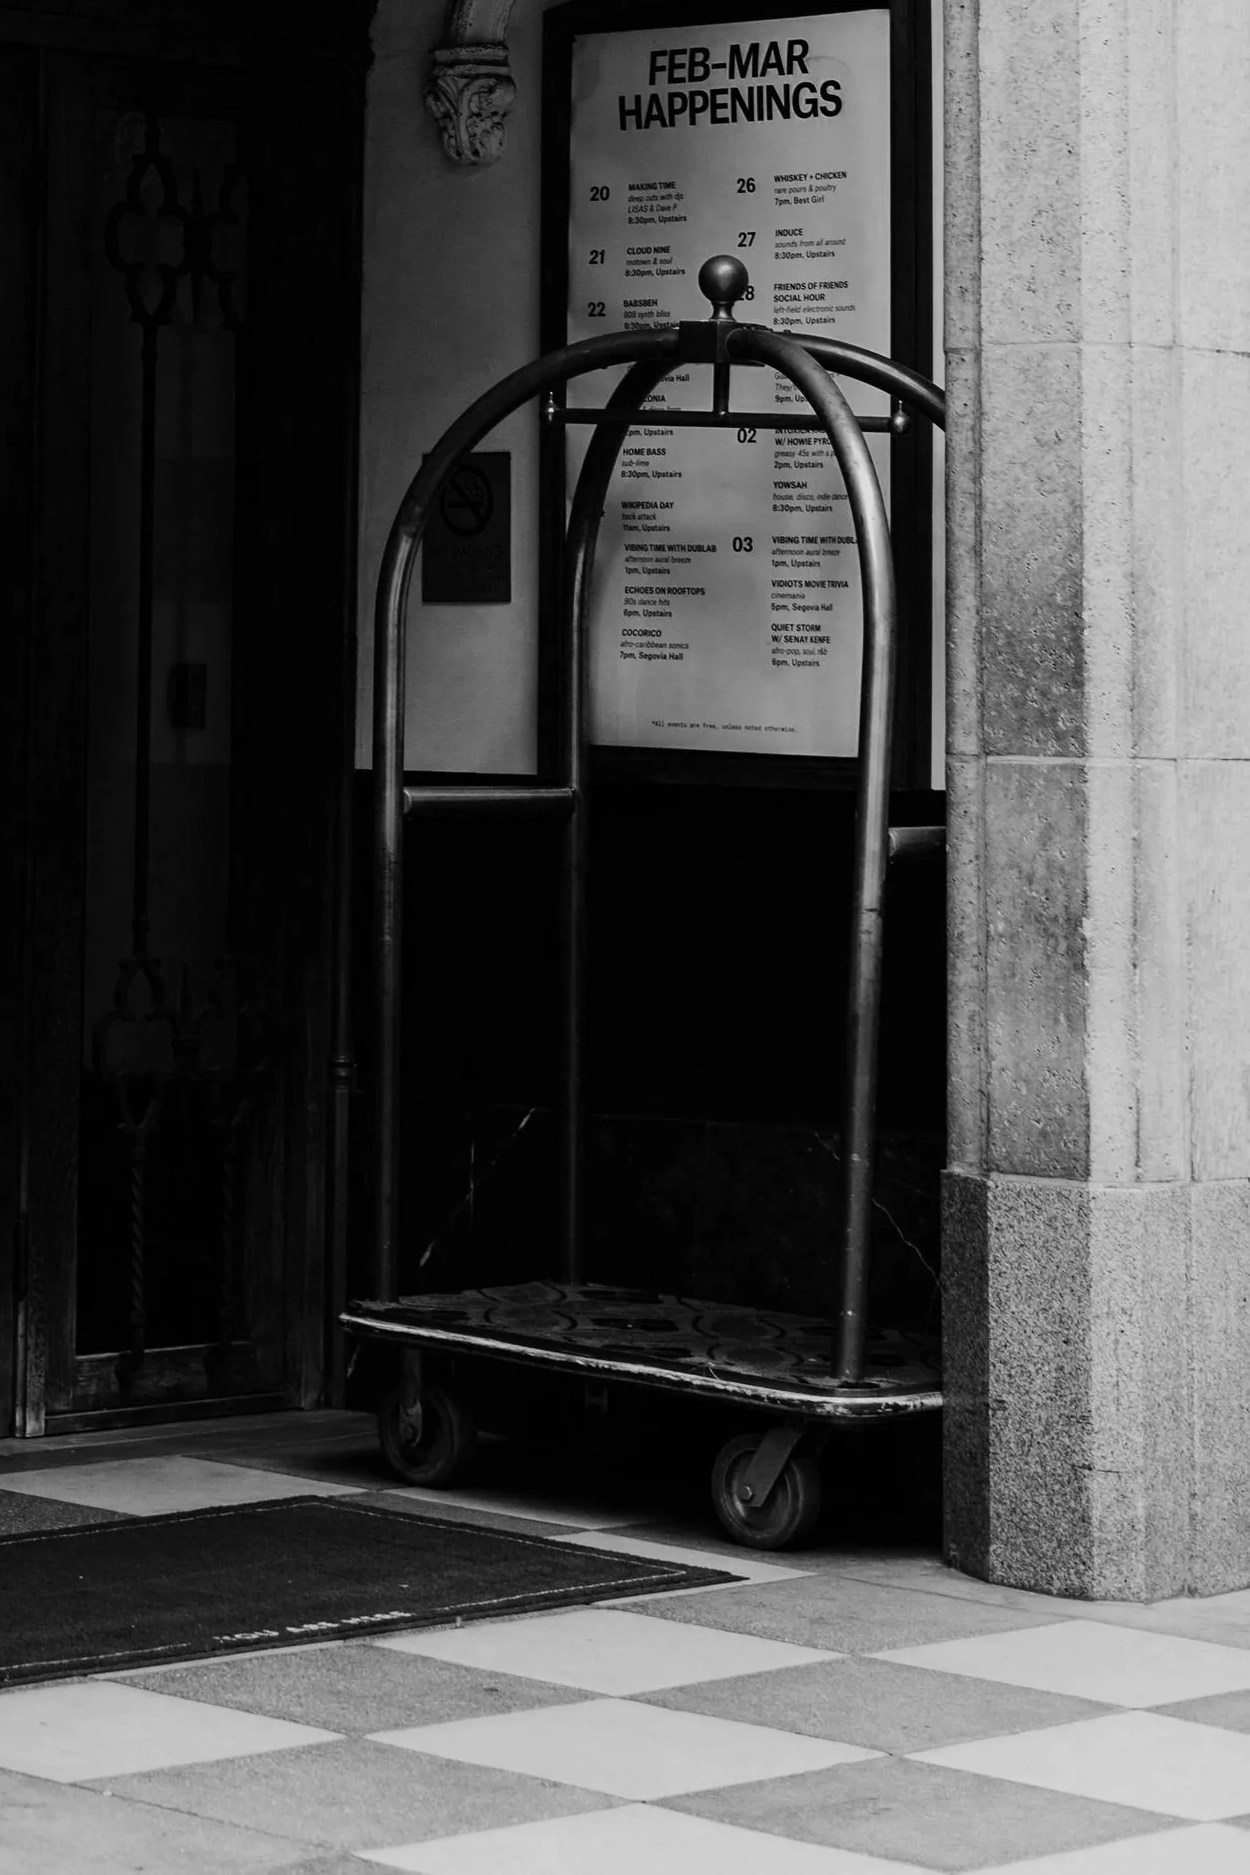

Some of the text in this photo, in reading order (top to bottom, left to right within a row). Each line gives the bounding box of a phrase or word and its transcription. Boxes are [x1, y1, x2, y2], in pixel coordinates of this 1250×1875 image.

[648, 39, 809, 85] FEB-MAR
[618, 80, 842, 131] HAPPENINGS
[774, 174, 807, 182] WHISKEY
[815, 171, 846, 180] CHICKEN
[628, 181, 675, 191] MAKING TIME
[737, 177, 755, 193] 26
[815, 184, 837, 193] poultry
[590, 186, 610, 201] 20
[794, 196, 809, 204] Best
[811, 195, 824, 203] Girl
[656, 204, 671, 212] Dave
[658, 215, 687, 224] Upstairs
[738, 232, 756, 247] 27
[825, 238, 845, 246] around
[627, 246, 670, 255] CLOUD NINE
[806, 250, 835, 259] Upstairs
[588, 249, 605, 265] 21
[656, 268, 685, 277] Upstairs
[774, 283, 806, 291] FRIENDS
[819, 281, 848, 289] FRIENDS
[774, 293, 825, 302] SOCIAL HOUR
[588, 302, 606, 317] 22
[803, 305, 834, 313] electronic
[806, 316, 835, 325] Upstairs
[676, 374, 690, 382] Hall
[737, 428, 756, 443] 02
[775, 438, 786, 446] W/
[794, 461, 823, 469] Upstairs
[652, 470, 682, 478] Upstairs
[774, 481, 807, 489] YOWSAH
[621, 501, 658, 509] WIKIPEDIA
[806, 504, 833, 512] Upstairs
[642, 524, 670, 532] Upstairs
[733, 537, 753, 552] 03
[772, 536, 856, 544] VIBING TIME WITH DUBL
[624, 543, 648, 551] VIBING
[649, 544, 666, 552] TIME
[667, 544, 686, 552] WITH
[625, 555, 653, 563] afternoon
[655, 555, 670, 563] aural
[791, 559, 820, 567] Upstairs
[642, 567, 670, 575] Upstairs
[771, 580, 803, 588] VIDIOTS
[805, 580, 826, 588] MOVIE
[625, 586, 654, 594] ECHOES
[667, 587, 705, 595] ROOFTOPS
[792, 603, 819, 612] Segovia
[821, 603, 833, 611] Hall
[643, 609, 672, 617] Upstairs
[771, 623, 820, 632] QUIET STORM
[622, 629, 662, 637] COCORICO
[772, 635, 782, 643] W/
[784, 635, 808, 643] SENAY
[639, 651, 667, 661] Segovia
[792, 658, 820, 667] Upstairs
